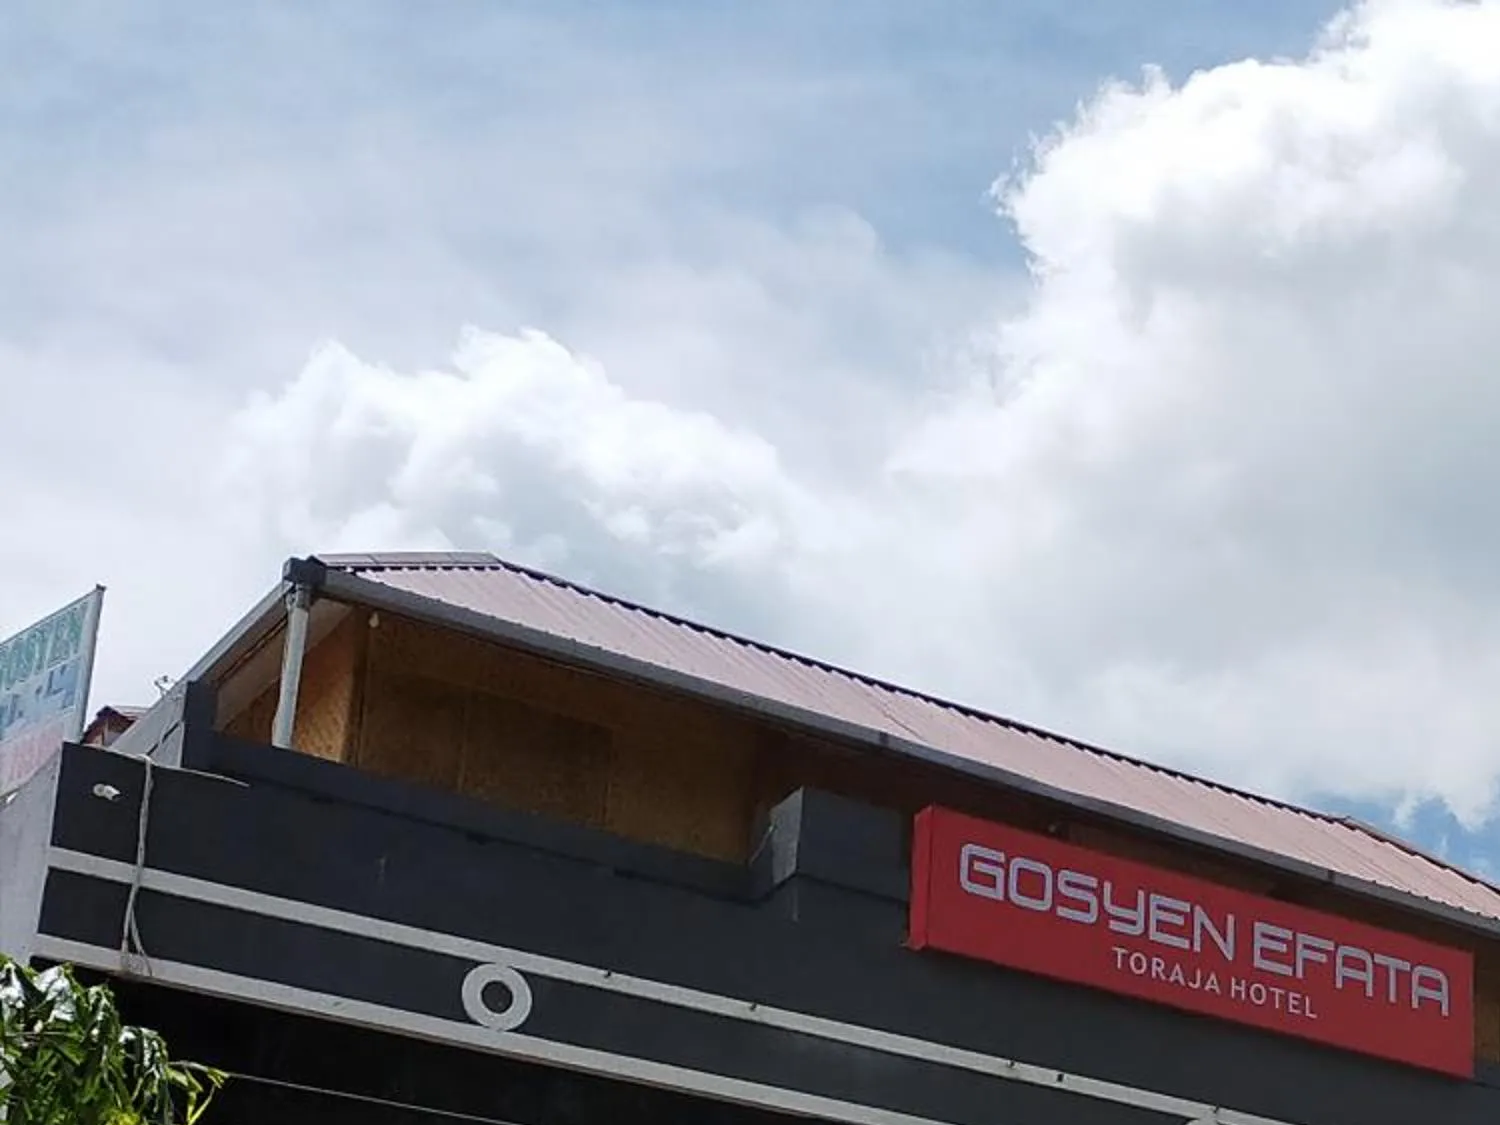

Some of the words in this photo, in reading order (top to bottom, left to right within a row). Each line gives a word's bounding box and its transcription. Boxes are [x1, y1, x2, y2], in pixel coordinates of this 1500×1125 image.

[959, 842, 1236, 961] GOSYEN
[1252, 921, 1450, 1016] EFATA
[1111, 946, 1222, 996] TORAJA
[1231, 976, 1318, 1019] HOTEL
